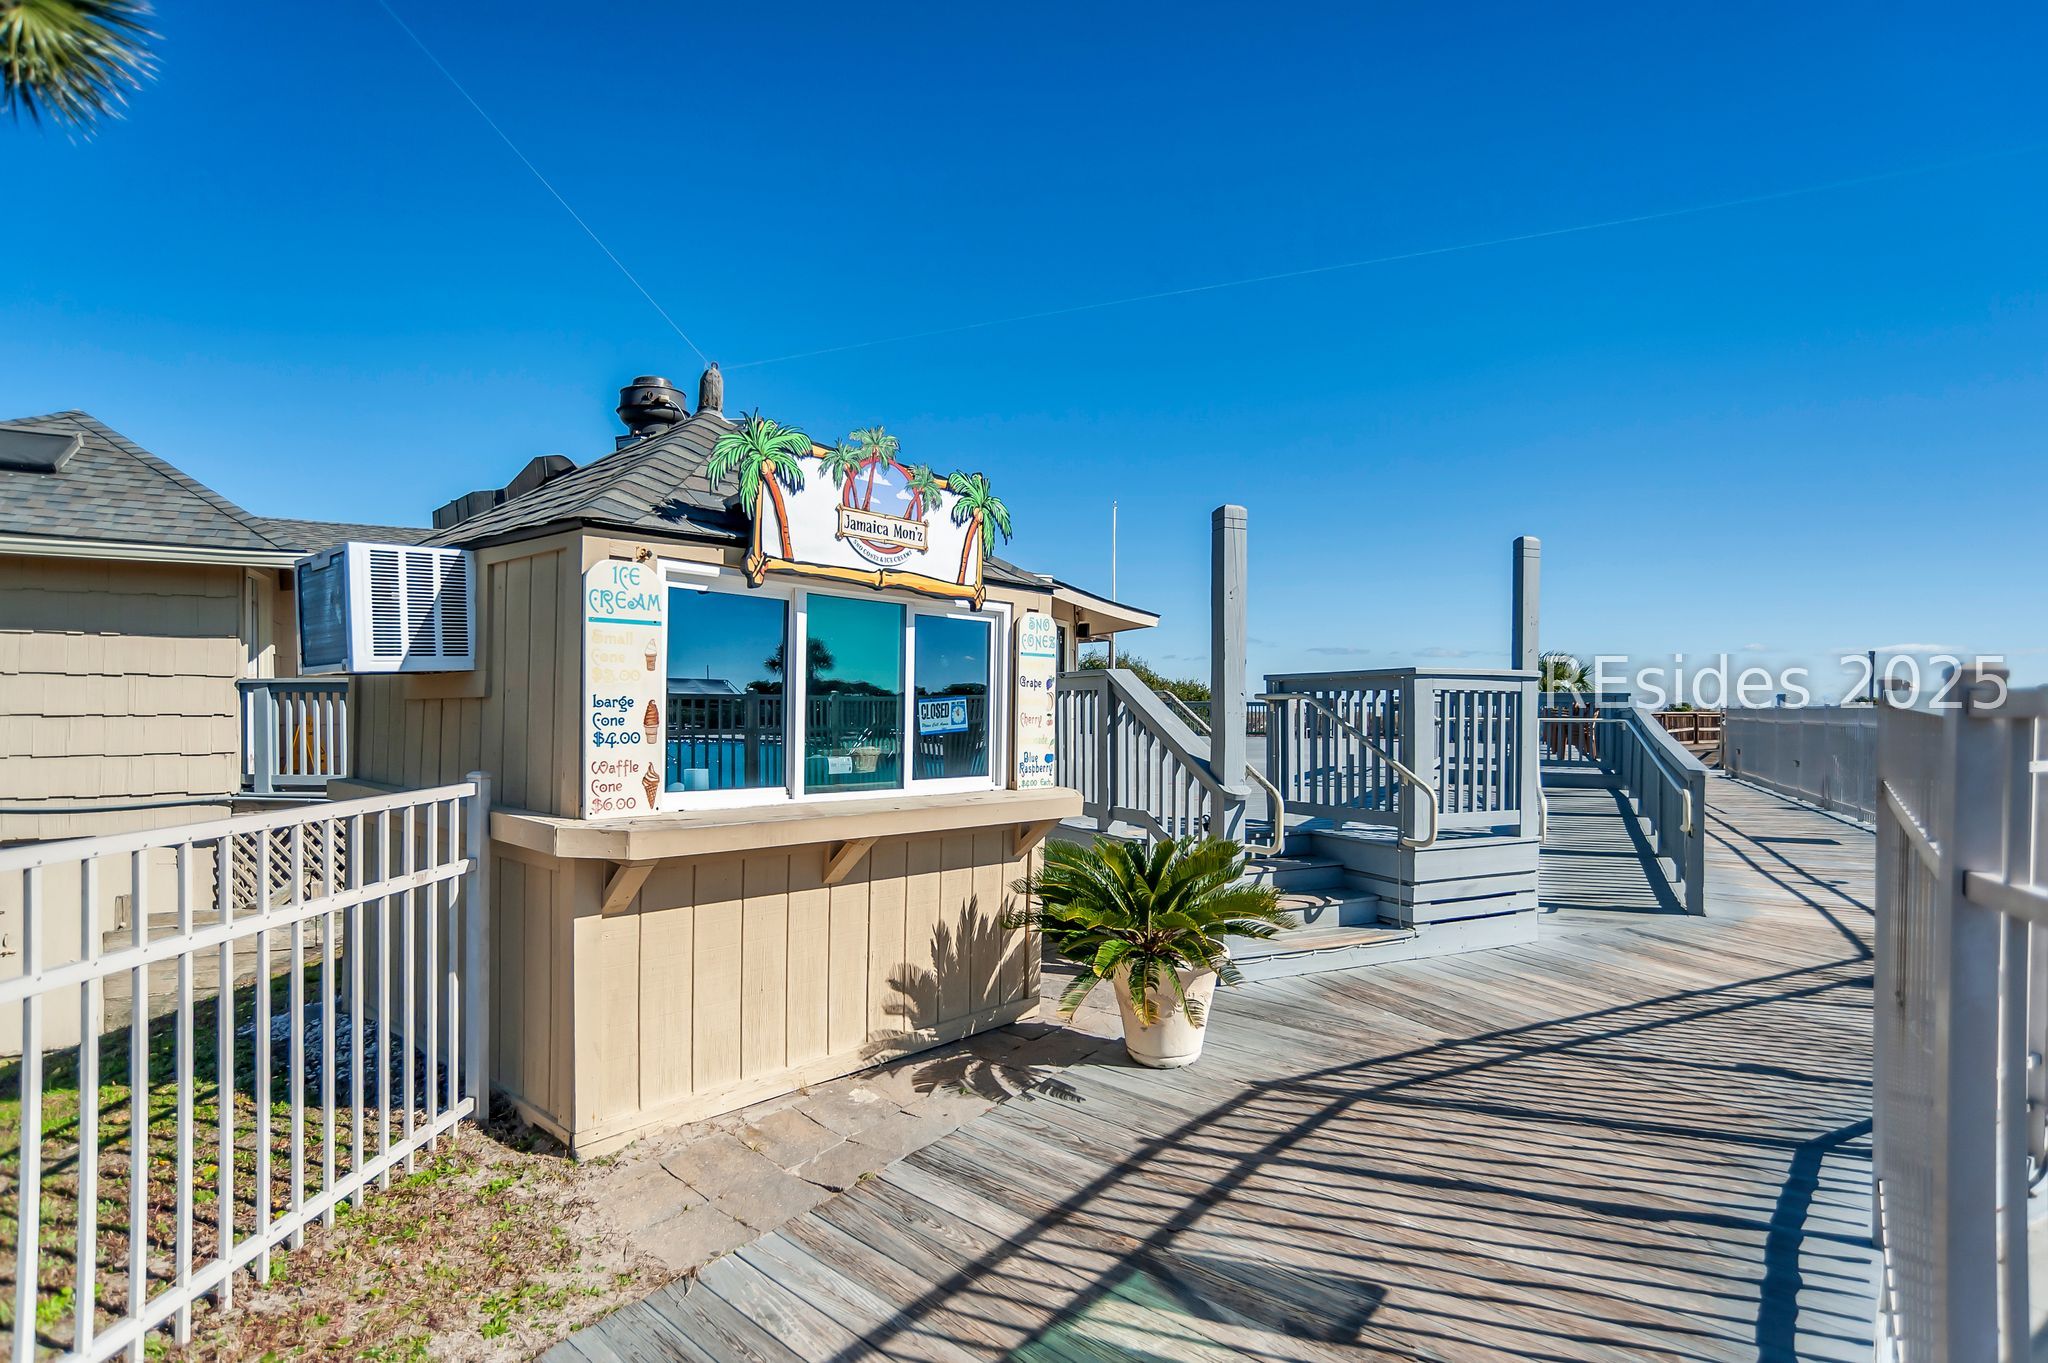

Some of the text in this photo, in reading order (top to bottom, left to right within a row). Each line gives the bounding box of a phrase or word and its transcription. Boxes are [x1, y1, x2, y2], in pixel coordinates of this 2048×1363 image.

[844, 514, 922, 541] Jamaica Mon'z
[612, 566, 641, 591] ICE
[588, 589, 661, 615] CREAM
[1028, 616, 1050, 633] SNO
[591, 629, 634, 645] Small
[591, 648, 625, 666] Cone
[1019, 675, 1042, 691] Grape
[592, 694, 635, 713] Large
[920, 702, 950, 720] CLOSED
[592, 712, 625, 731] Cone
[1020, 712, 1043, 728] Cherry
[592, 731, 641, 748] $4.00
[1023, 751, 1039, 763] Blue
[591, 760, 639, 778] Waffle
[1019, 761, 1053, 777] Raspberry
[591, 779, 623, 797] Cone
[591, 797, 637, 814] $6.00
